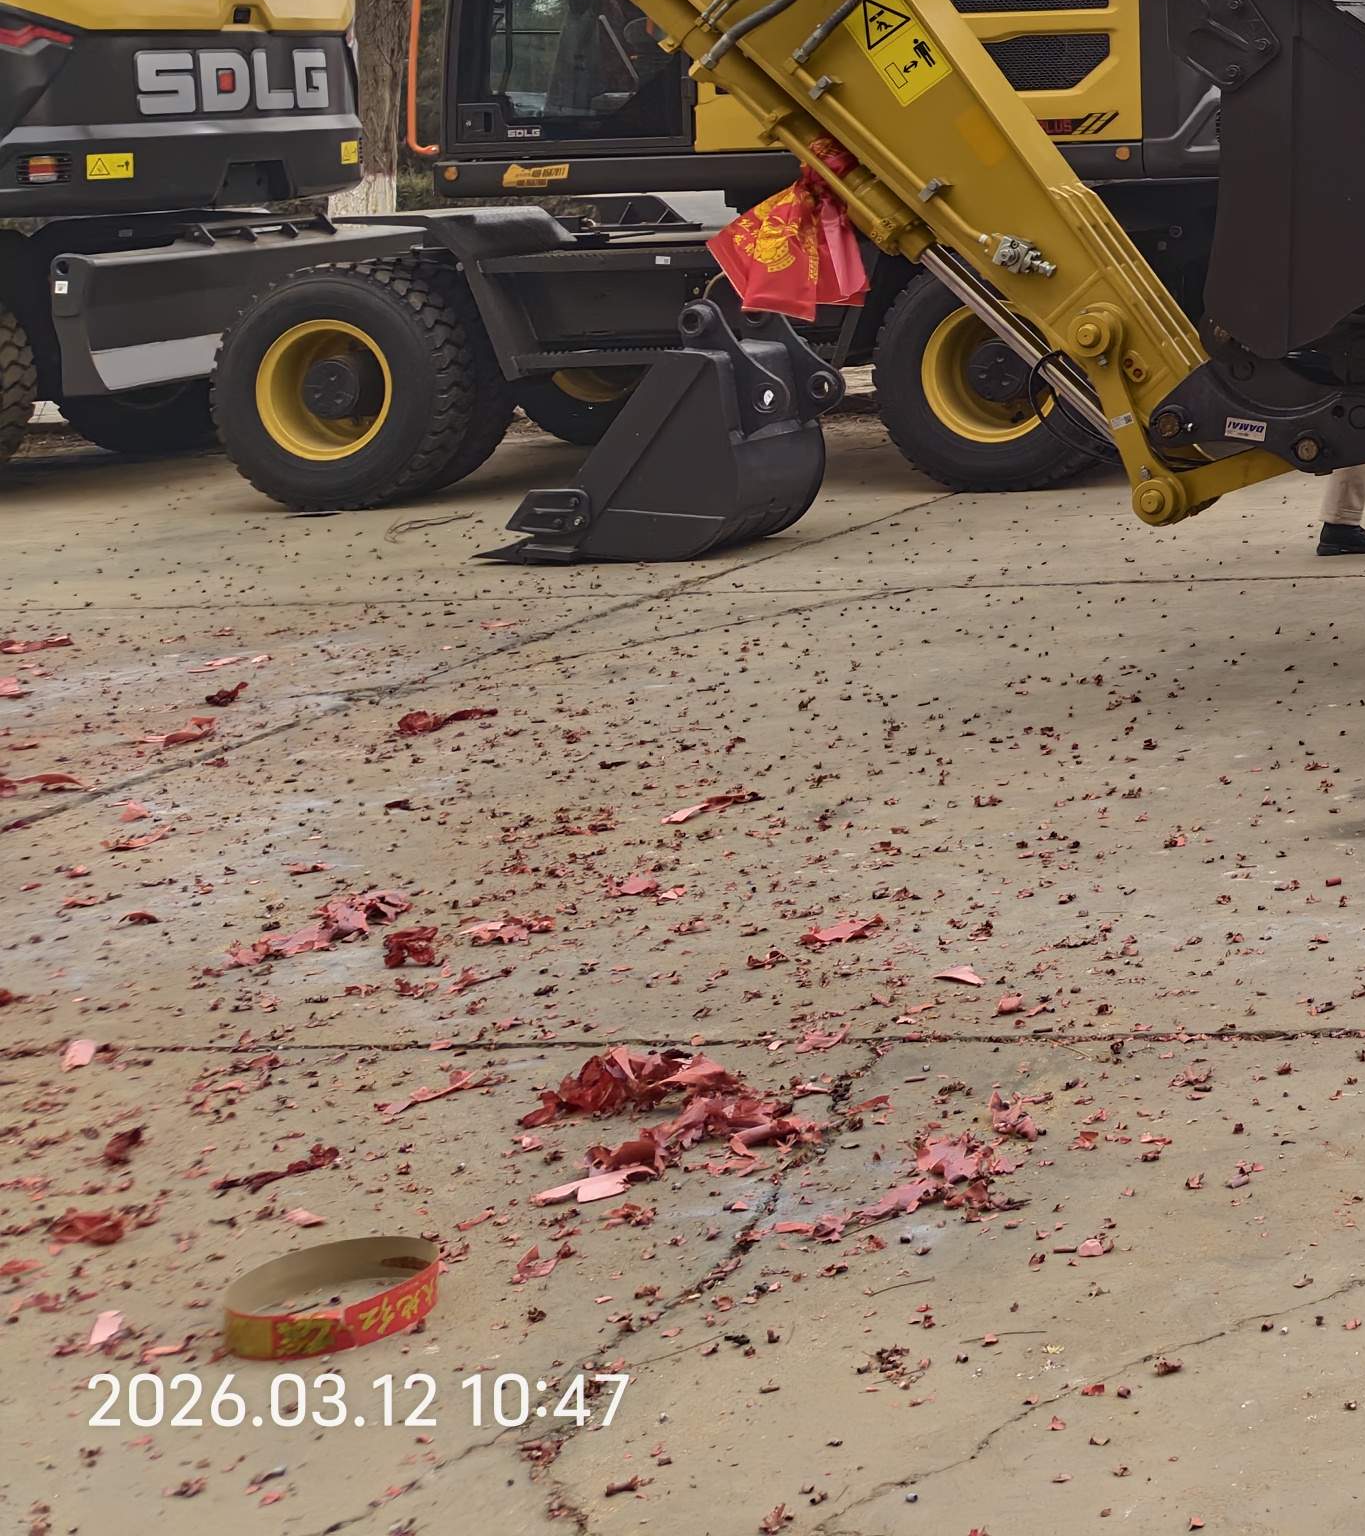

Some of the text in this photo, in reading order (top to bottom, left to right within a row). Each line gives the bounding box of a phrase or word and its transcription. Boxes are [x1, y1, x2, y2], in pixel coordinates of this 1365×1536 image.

[135, 48, 330, 116] SDLG
[507, 128, 541, 138] SDLG
[1227, 421, 1265, 433] DAMAI
